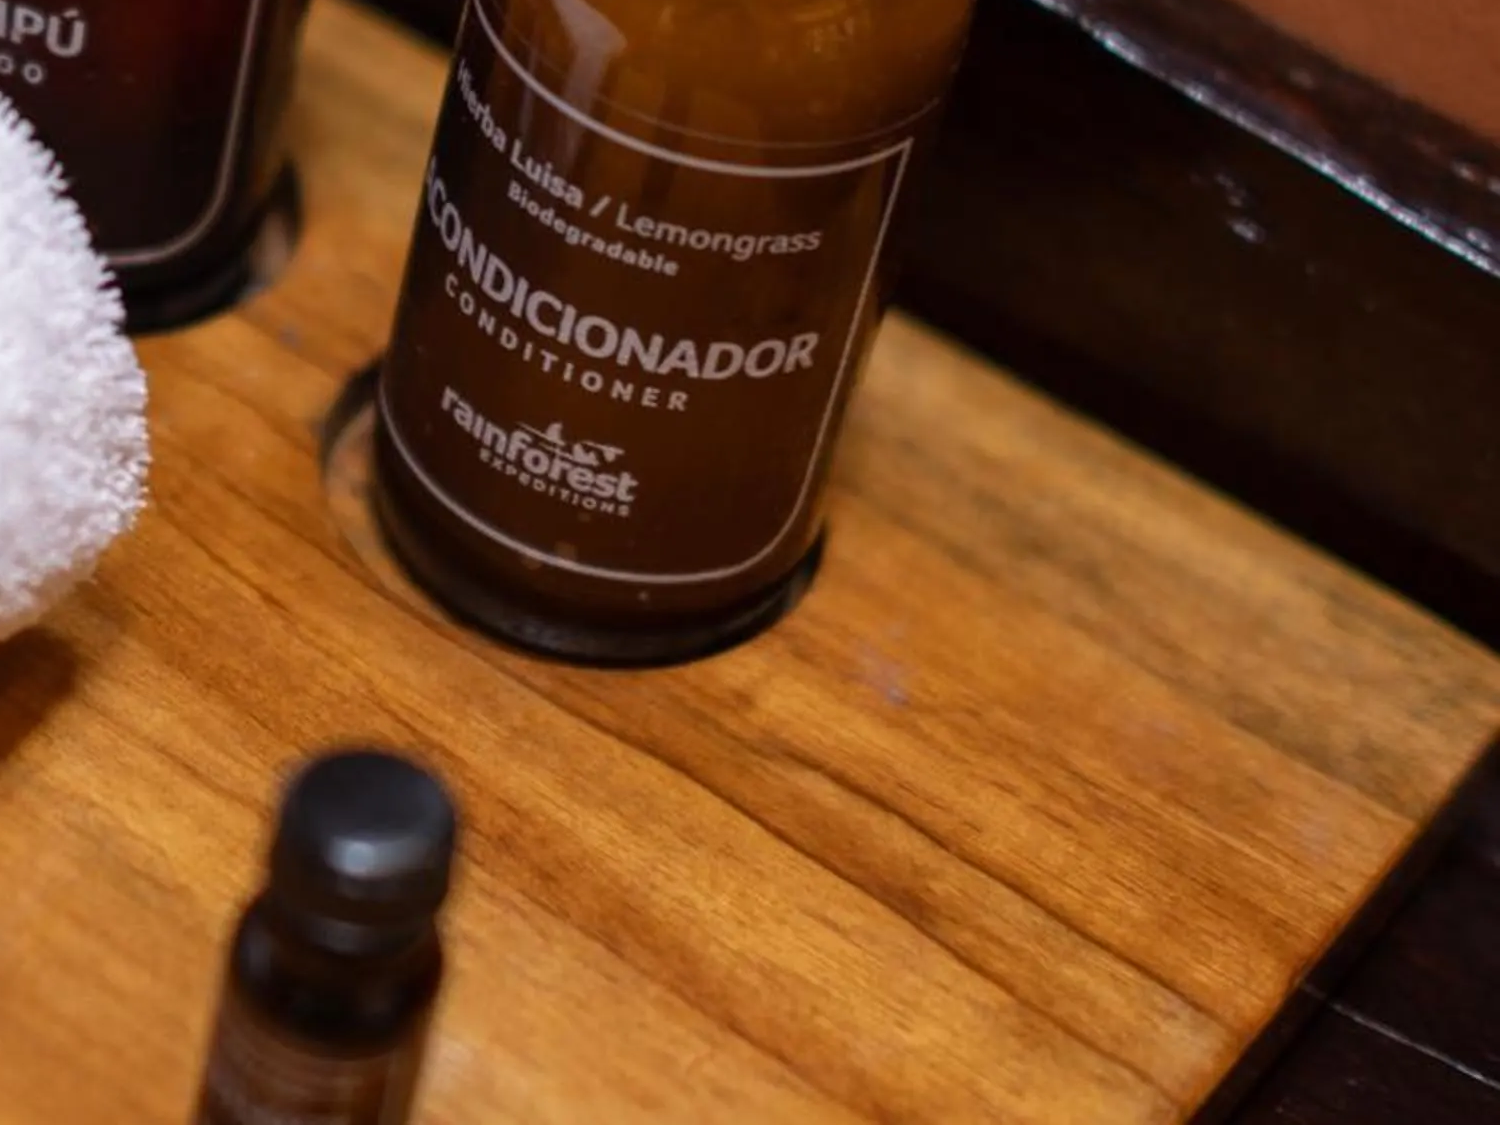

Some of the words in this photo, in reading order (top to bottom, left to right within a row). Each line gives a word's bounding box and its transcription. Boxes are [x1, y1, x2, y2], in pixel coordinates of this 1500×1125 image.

[507, 178, 679, 276] Biodegradable
[509, 138, 584, 210] Luisa
[589, 195, 612, 218] /
[616, 202, 823, 261] Lemongrass
[445, 273, 689, 412] CONDITIONER
[441, 386, 639, 503] rainforest
[479, 447, 630, 518] EXPEDITIONS
